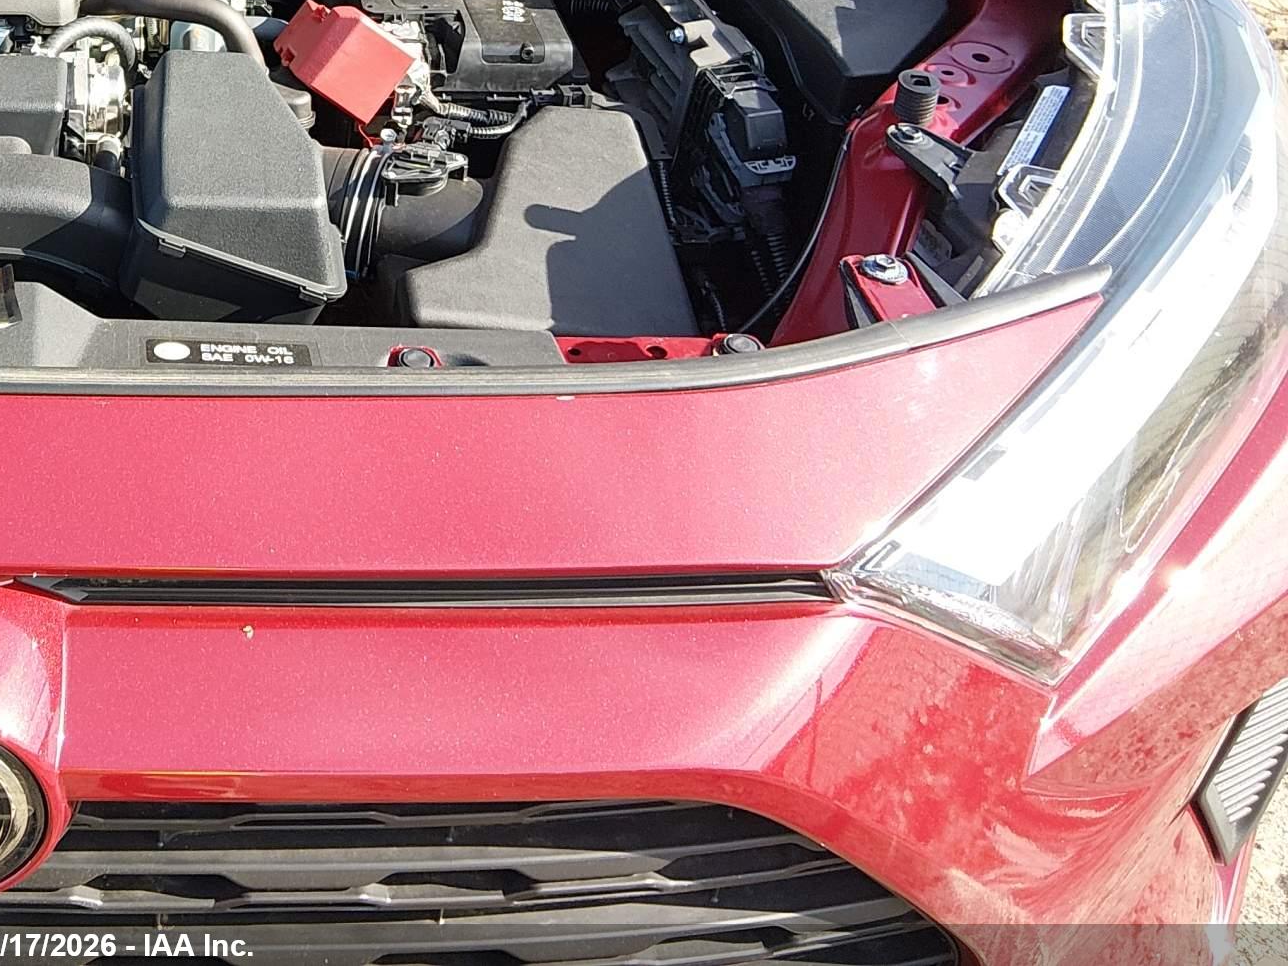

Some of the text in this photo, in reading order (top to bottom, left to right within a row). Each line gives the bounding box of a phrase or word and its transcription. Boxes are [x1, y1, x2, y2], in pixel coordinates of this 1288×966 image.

[200, 343, 294, 355] ENGINE OIL
[201, 353, 295, 365] SAE 0W-16
